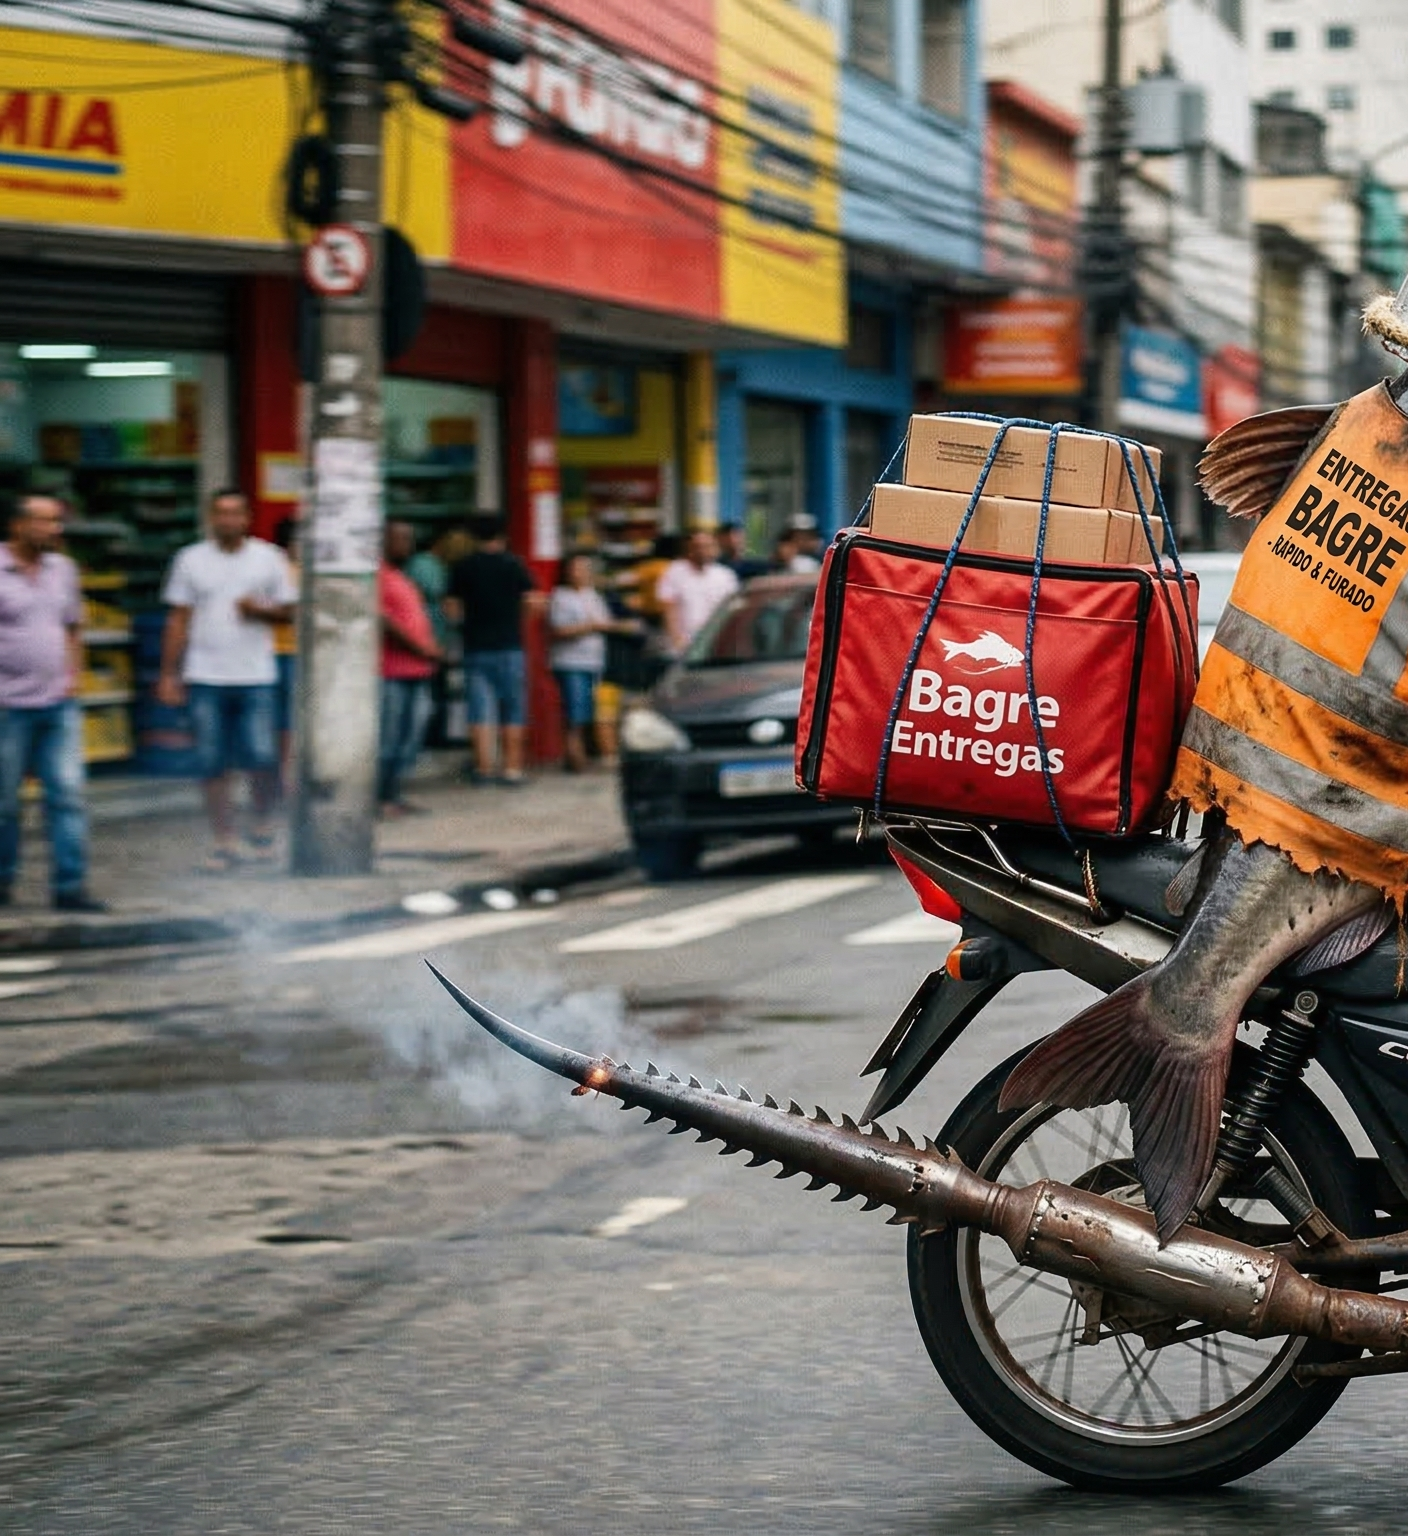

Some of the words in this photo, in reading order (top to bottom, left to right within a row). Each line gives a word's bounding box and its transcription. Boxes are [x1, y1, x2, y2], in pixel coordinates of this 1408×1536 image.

[1285, 484, 1407, 588] BAGRE
[1310, 561, 1323, 580] &
[1321, 567, 1375, 613] FURADO
[908, 668, 1060, 733] Bagre
[891, 719, 1065, 777] Entregas
